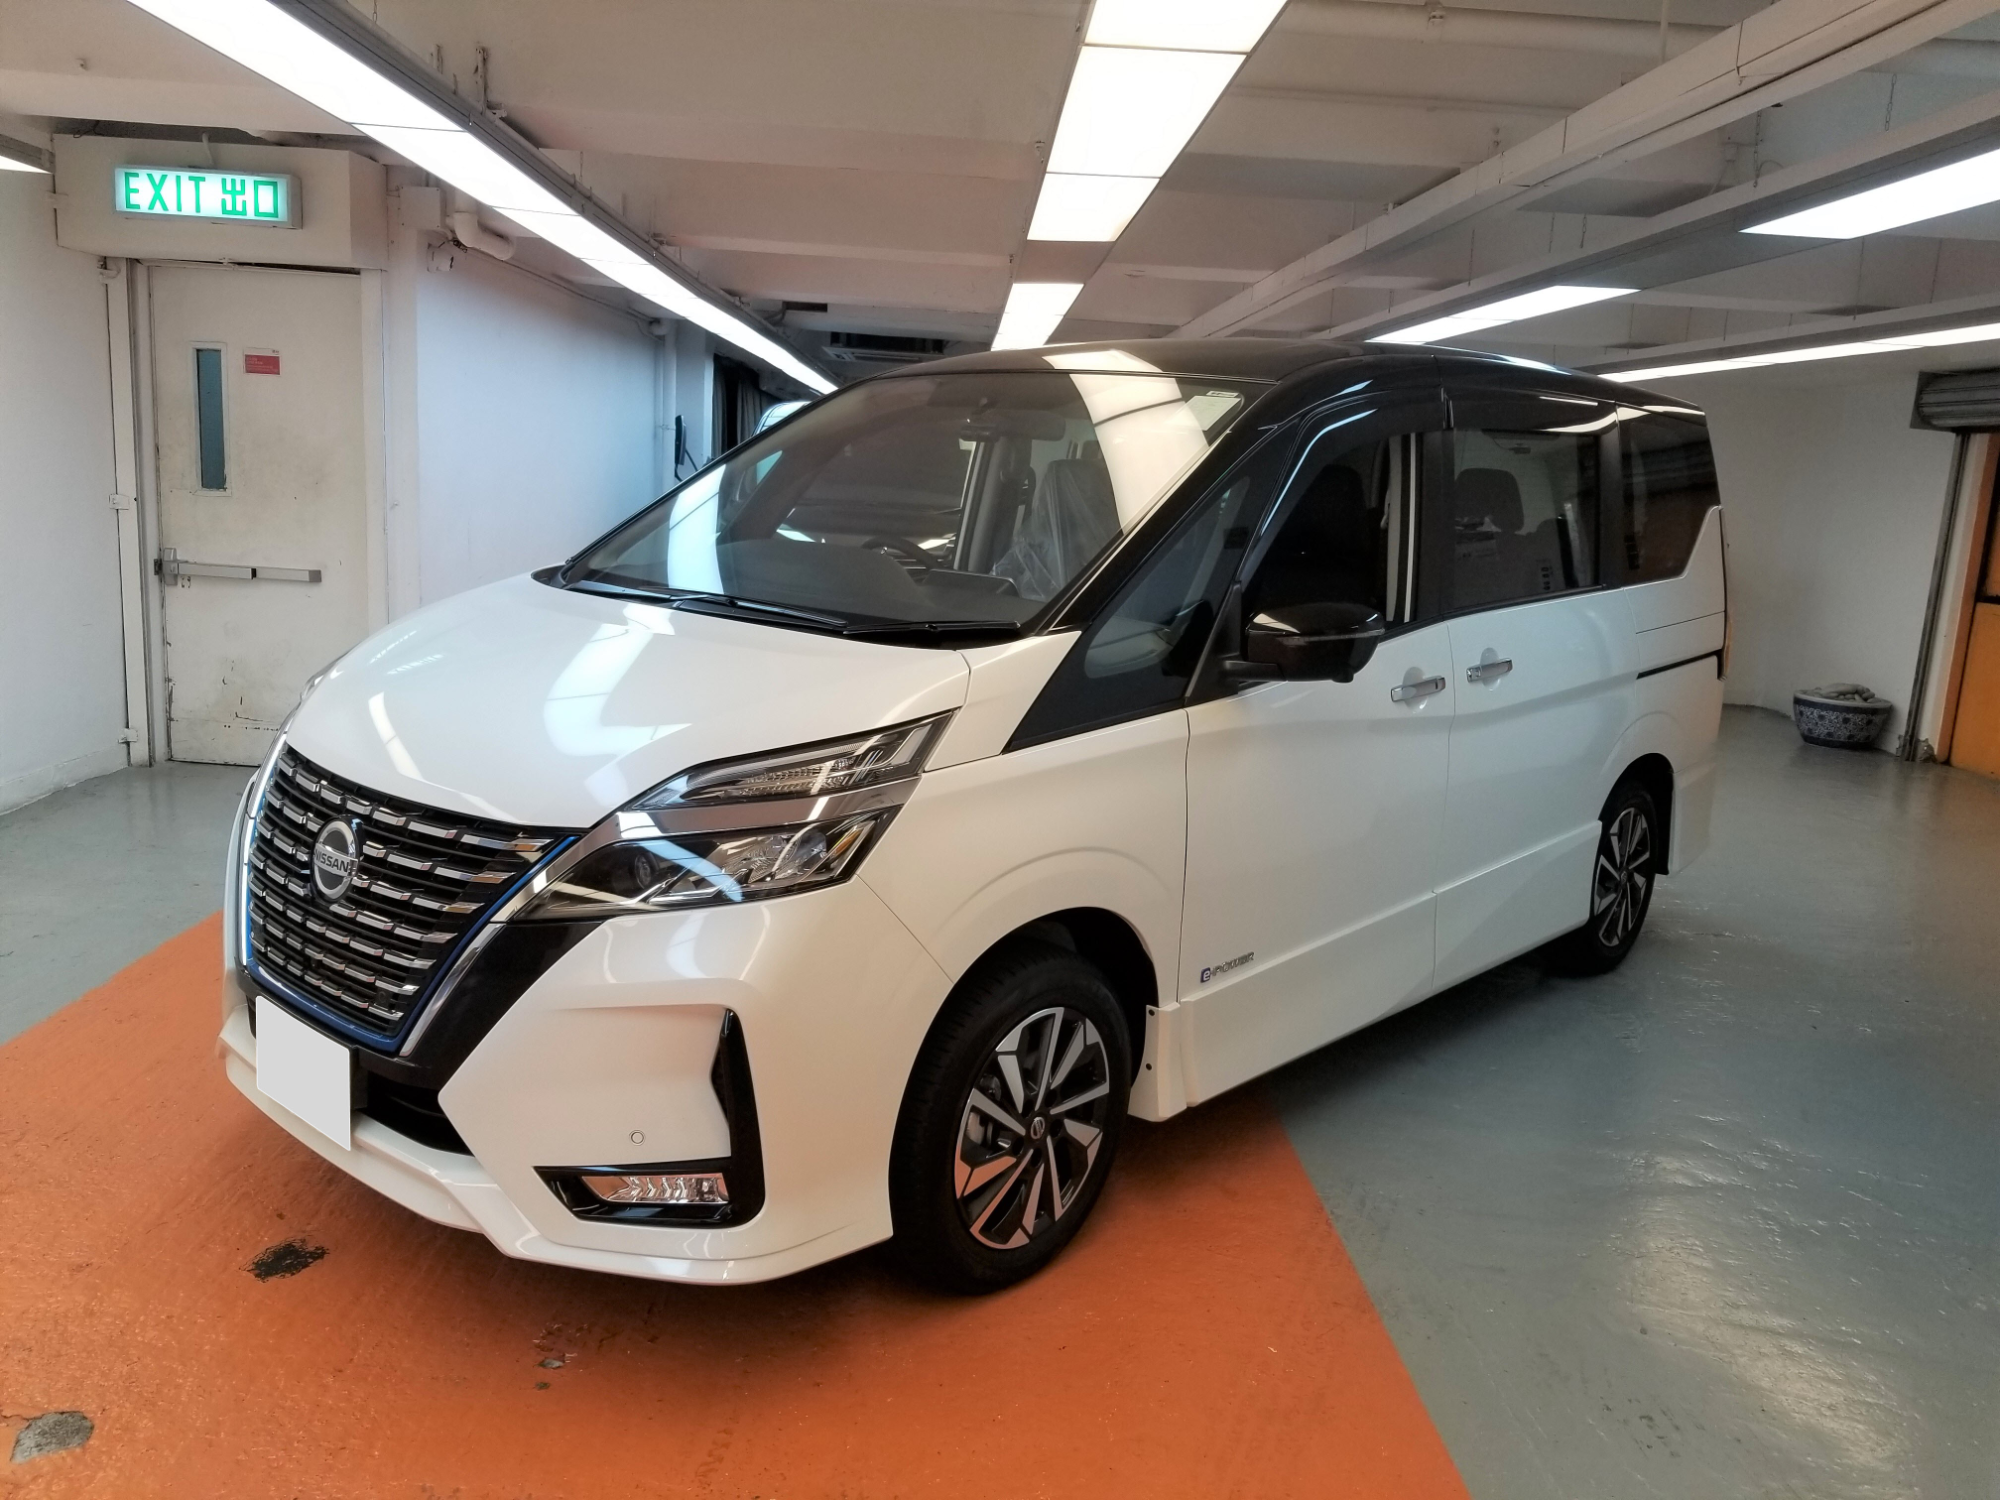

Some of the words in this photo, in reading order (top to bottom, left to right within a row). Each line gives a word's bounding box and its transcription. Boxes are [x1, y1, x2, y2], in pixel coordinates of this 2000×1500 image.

[124, 171, 206, 213] EXIT
[221, 177, 279, 218] 出口
[315, 850, 350, 873] NISSAN
